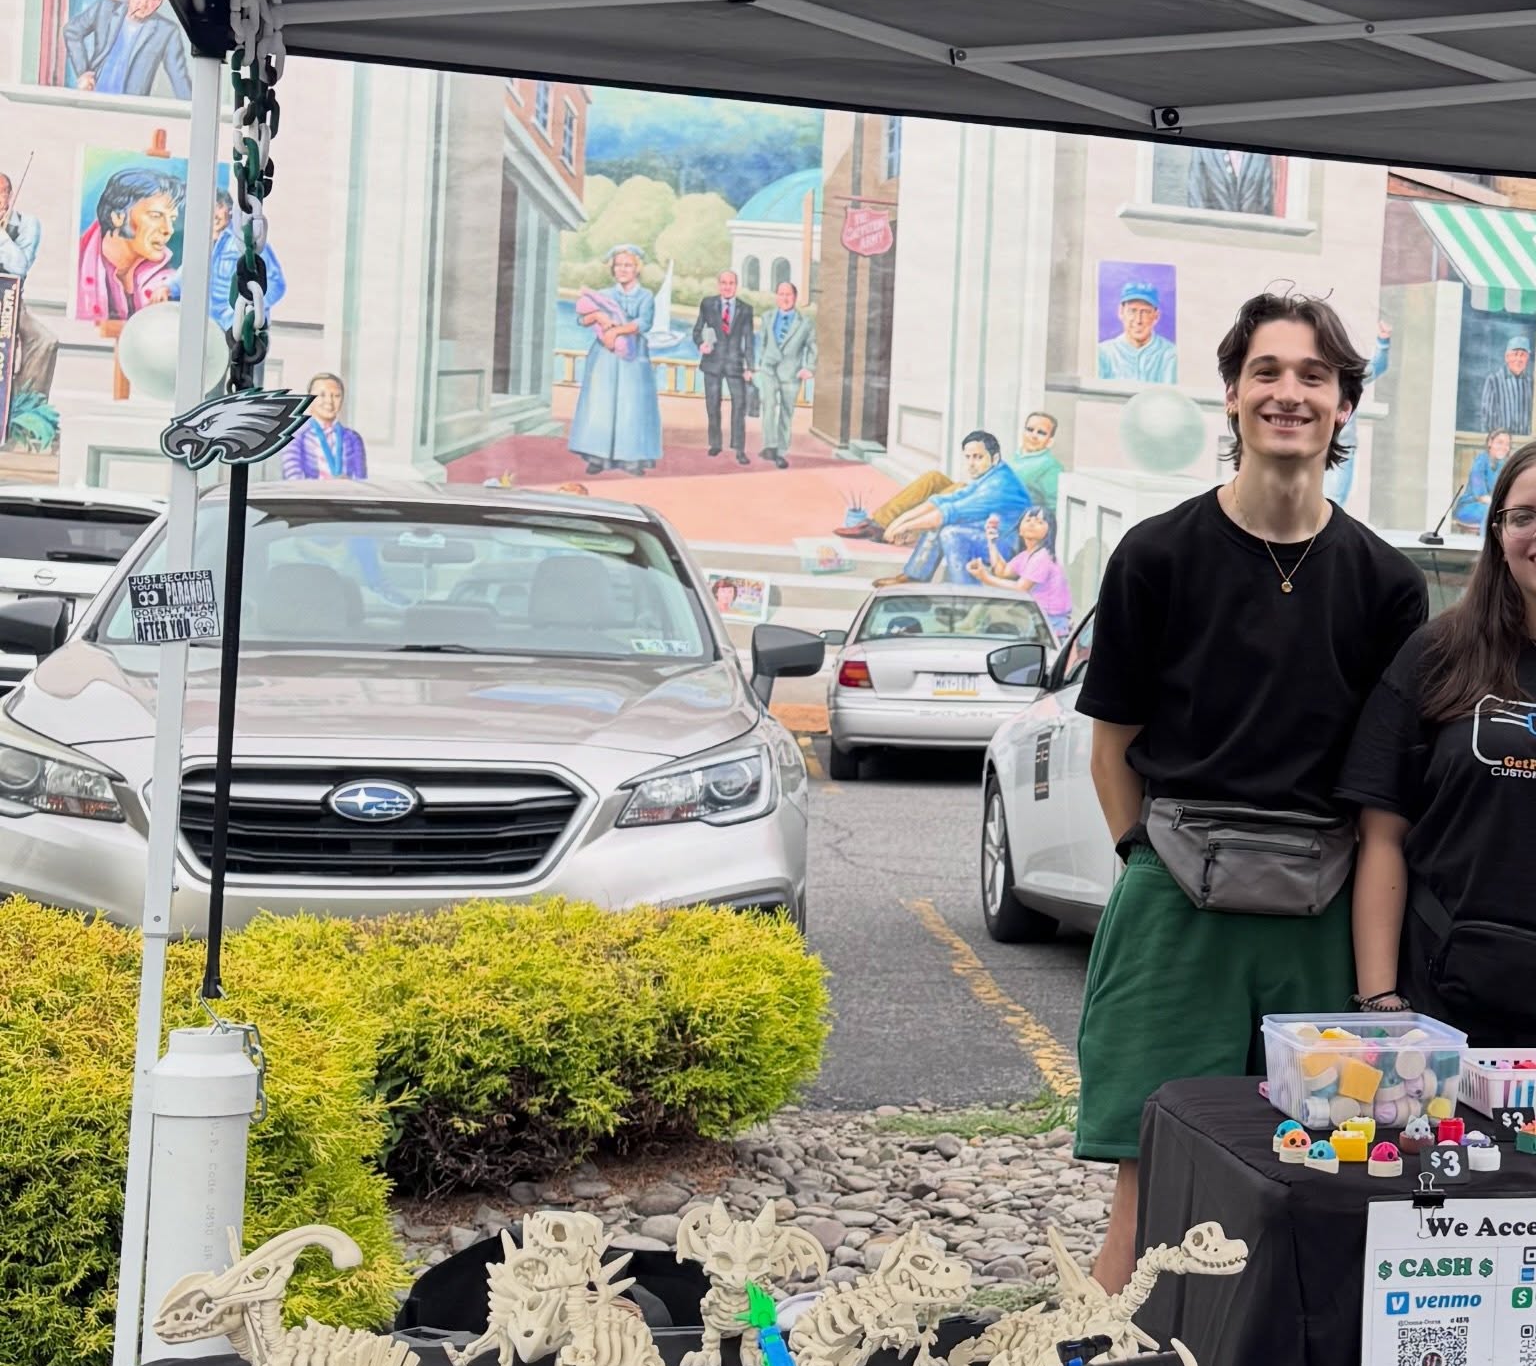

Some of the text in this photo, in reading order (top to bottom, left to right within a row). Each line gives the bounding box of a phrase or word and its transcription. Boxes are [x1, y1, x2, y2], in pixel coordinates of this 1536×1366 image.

[131, 571, 210, 585] JUST BECAUSE
[131, 579, 214, 606] YOU'RE PARANOID
[137, 617, 191, 642] AFTER YOU
[1430, 1150, 1461, 1177] $3
[1426, 1217, 1469, 1237] We
[1378, 1257, 1494, 1280] $ CASH $
[1415, 1293, 1482, 1309] venmo
